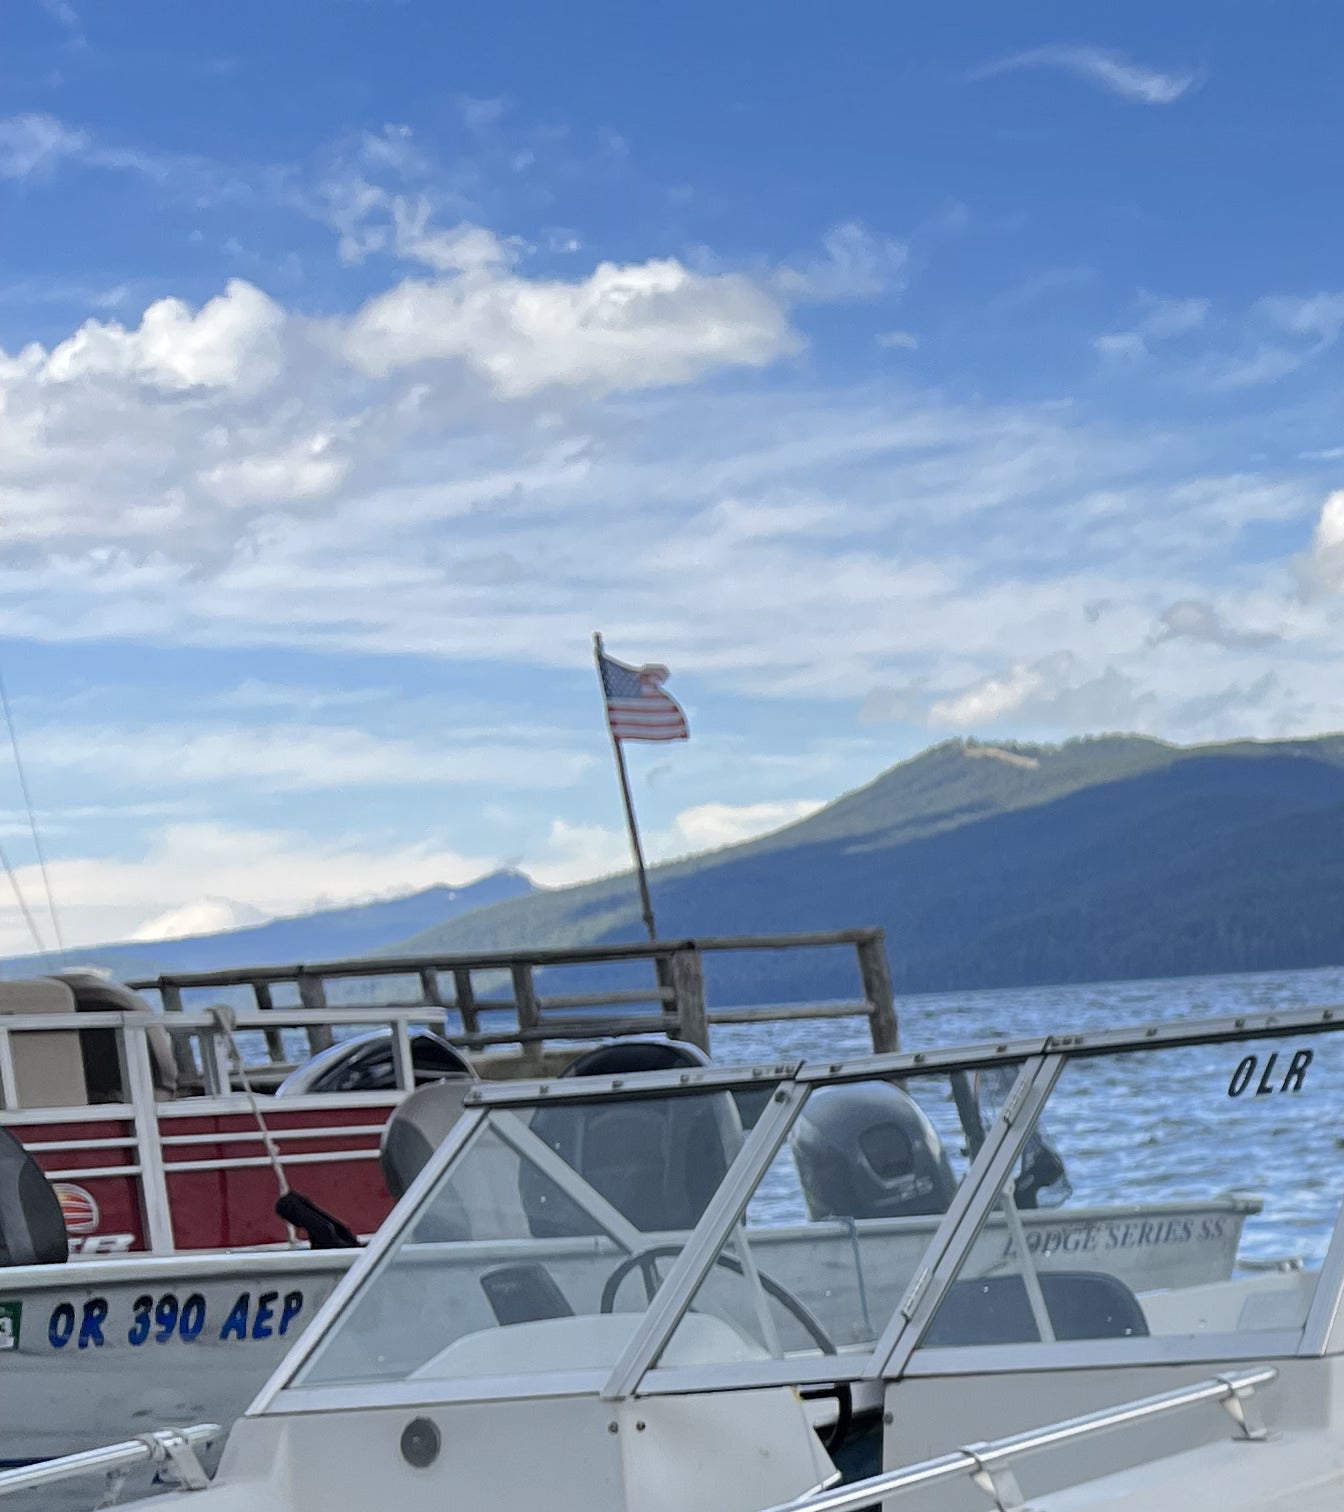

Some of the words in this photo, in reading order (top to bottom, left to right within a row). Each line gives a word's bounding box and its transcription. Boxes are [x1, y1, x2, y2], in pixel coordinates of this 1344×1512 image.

[1227, 1048, 1314, 1098] OLR
[1105, 1219, 1195, 1249] SERIES
[48, 1297, 108, 1349] OR
[128, 1292, 206, 1346] 390
[220, 1291, 304, 1341] AEP
